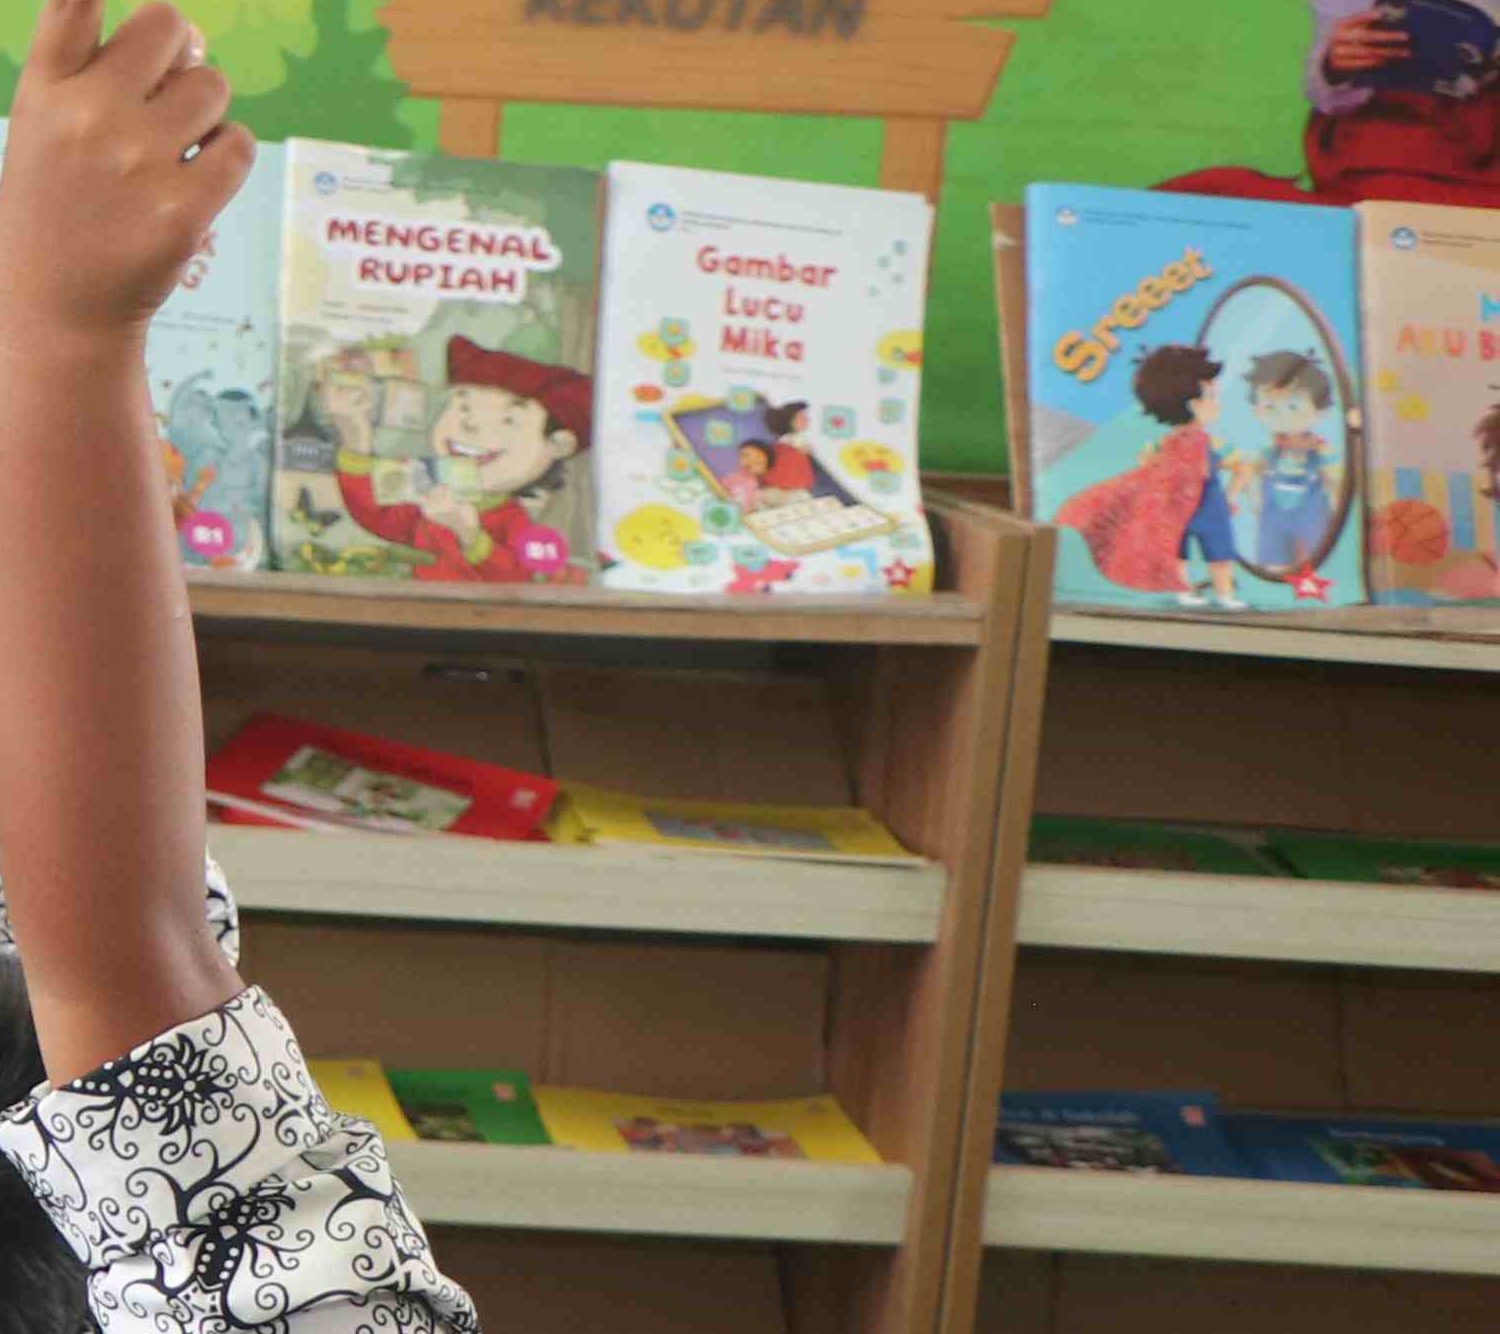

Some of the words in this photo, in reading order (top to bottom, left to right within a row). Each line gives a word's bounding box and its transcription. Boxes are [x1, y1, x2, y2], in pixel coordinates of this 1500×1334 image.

[325, 218, 552, 262] MENGENAL
[357, 259, 518, 294] RUPIAH
[696, 245, 838, 289] Gambar
[724, 287, 806, 324] Lucu
[1053, 245, 1214, 382] Sreet
[720, 326, 806, 363] Mika
